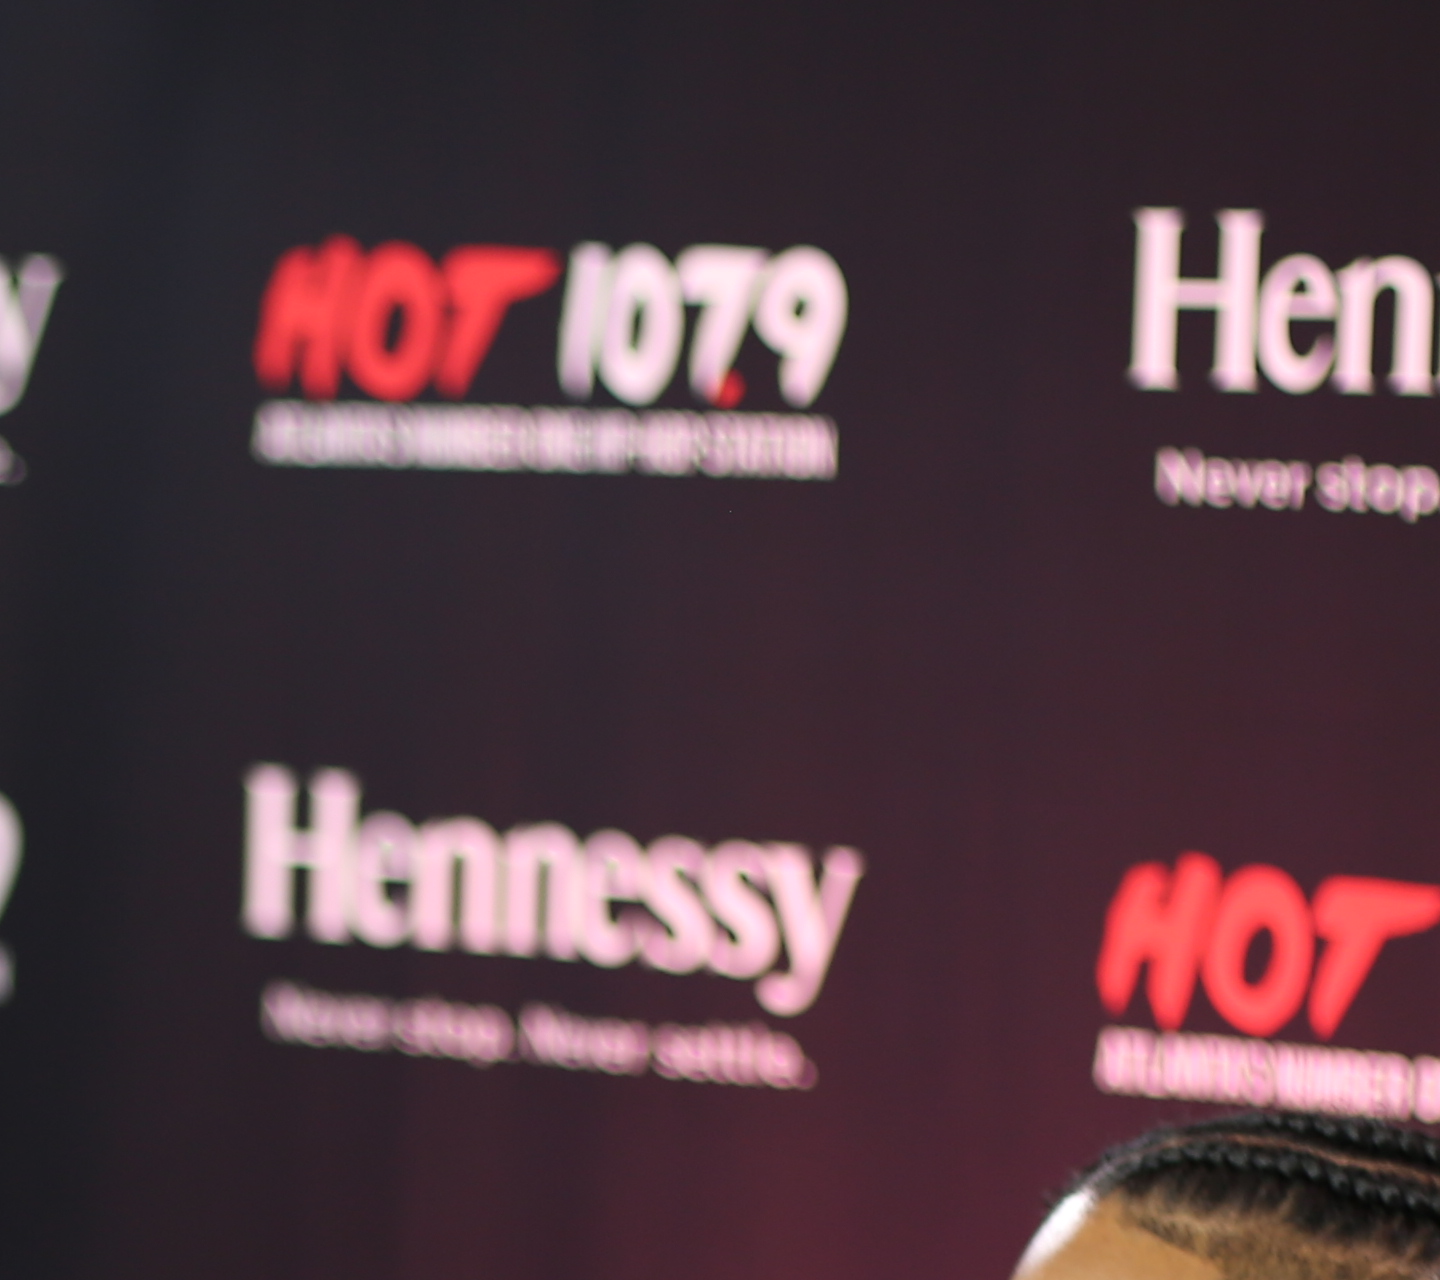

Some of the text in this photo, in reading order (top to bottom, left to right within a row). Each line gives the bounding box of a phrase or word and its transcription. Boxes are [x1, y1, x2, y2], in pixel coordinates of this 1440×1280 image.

[253, 233, 566, 402] HOT
[1154, 446, 1312, 511] Never
[242, 762, 866, 1017] Hennessy
